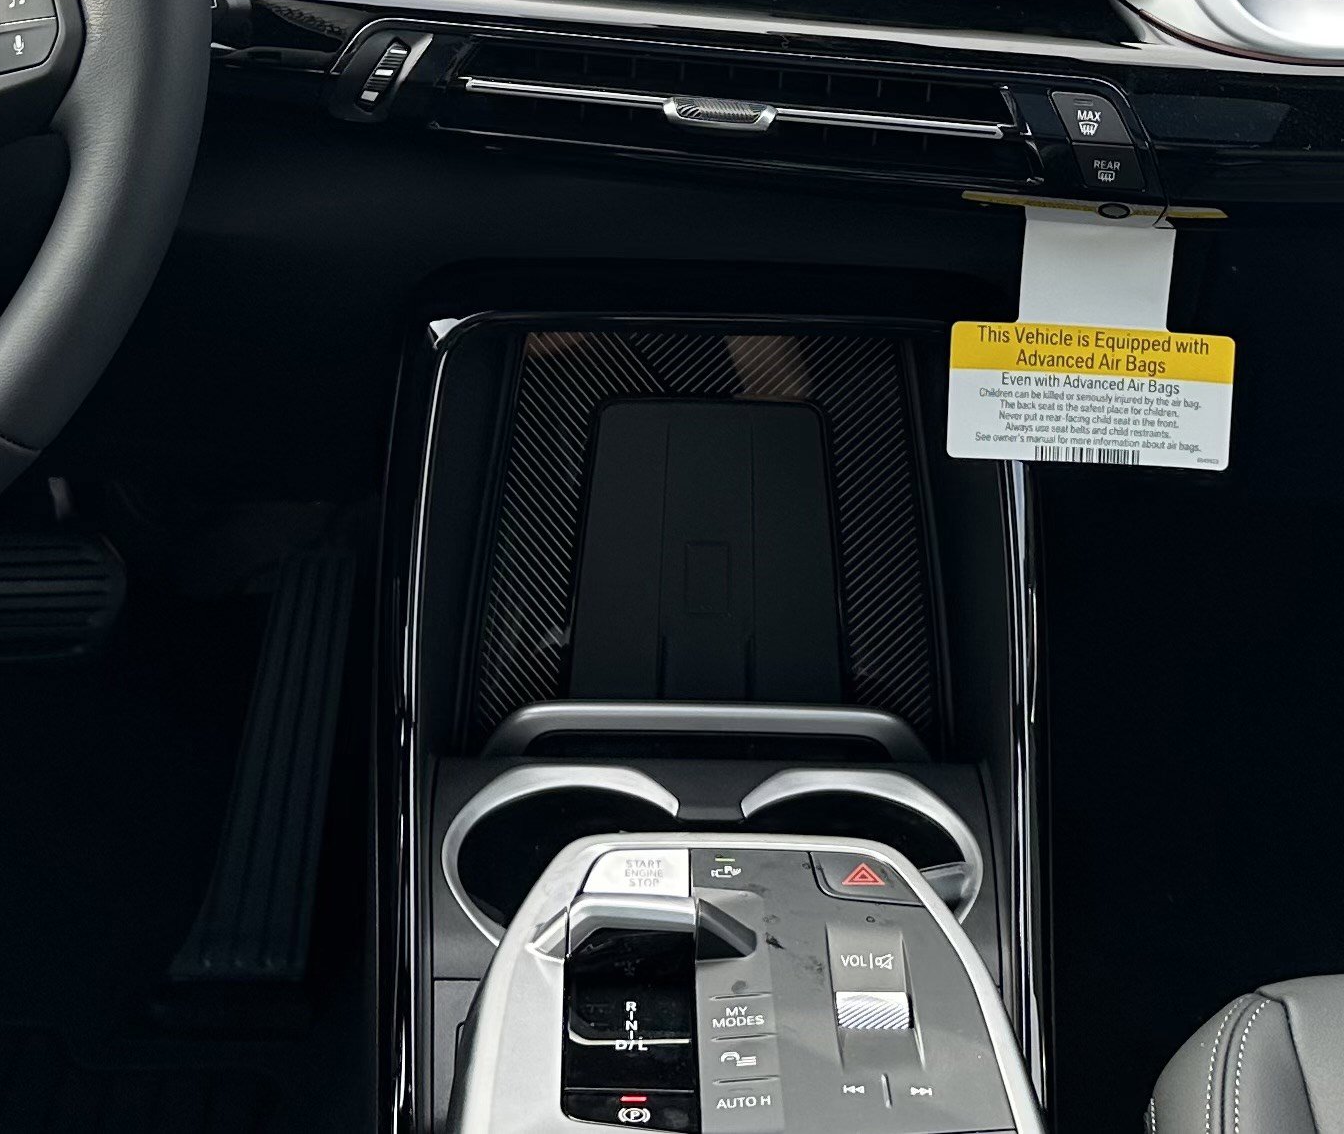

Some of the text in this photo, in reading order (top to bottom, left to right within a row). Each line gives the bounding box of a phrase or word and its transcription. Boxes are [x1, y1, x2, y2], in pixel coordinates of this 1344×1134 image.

[1077, 109, 1102, 122] MAX
[1093, 159, 1121, 171] REAR
[976, 325, 1210, 355] This Vehicle is Equipped with
[1015, 348, 1166, 378] Advanced Air Bags
[1001, 371, 1180, 397] Even with Advanced Air Bags
[979, 387, 1202, 411] Children can be killed or seriously injured by the air bag.
[999, 399, 1016, 410] The
[1017, 400, 1037, 411] back
[1038, 402, 1055, 411] seat
[1065, 402, 1079, 412] the
[1079, 403, 1105, 413] safest
[1106, 404, 1129, 416] place
[1130, 406, 1142, 415] for
[1143, 407, 1180, 418] children.
[998, 410, 1022, 421] Never
[1024, 411, 1037, 423] put
[1091, 415, 1112, 425] child
[1113, 416, 1131, 425] seat
[1141, 417, 1156, 427] the
[1157, 418, 1180, 429] front.
[1004, 421, 1172, 439] Always use seat belts and child restraints.
[975, 431, 992, 442] See
[1026, 434, 1056, 444] manual
[1057, 435, 1068, 445] for
[1069, 436, 1092, 445] more
[1093, 437, 1141, 447] information
[1141, 439, 1166, 449] about
[1166, 440, 1177, 449] air
[1178, 441, 1202, 454] bags.
[625, 859, 662, 869] START
[624, 868, 664, 878] ENGINE
[628, 878, 660, 888] STOP
[840, 954, 867, 967] VOL
[625, 1001, 637, 1012] R
[725, 1006, 748, 1017] MY
[625, 1020, 638, 1031] N
[712, 1015, 765, 1029] MODES
[716, 1095, 772, 1110] AUTO H
